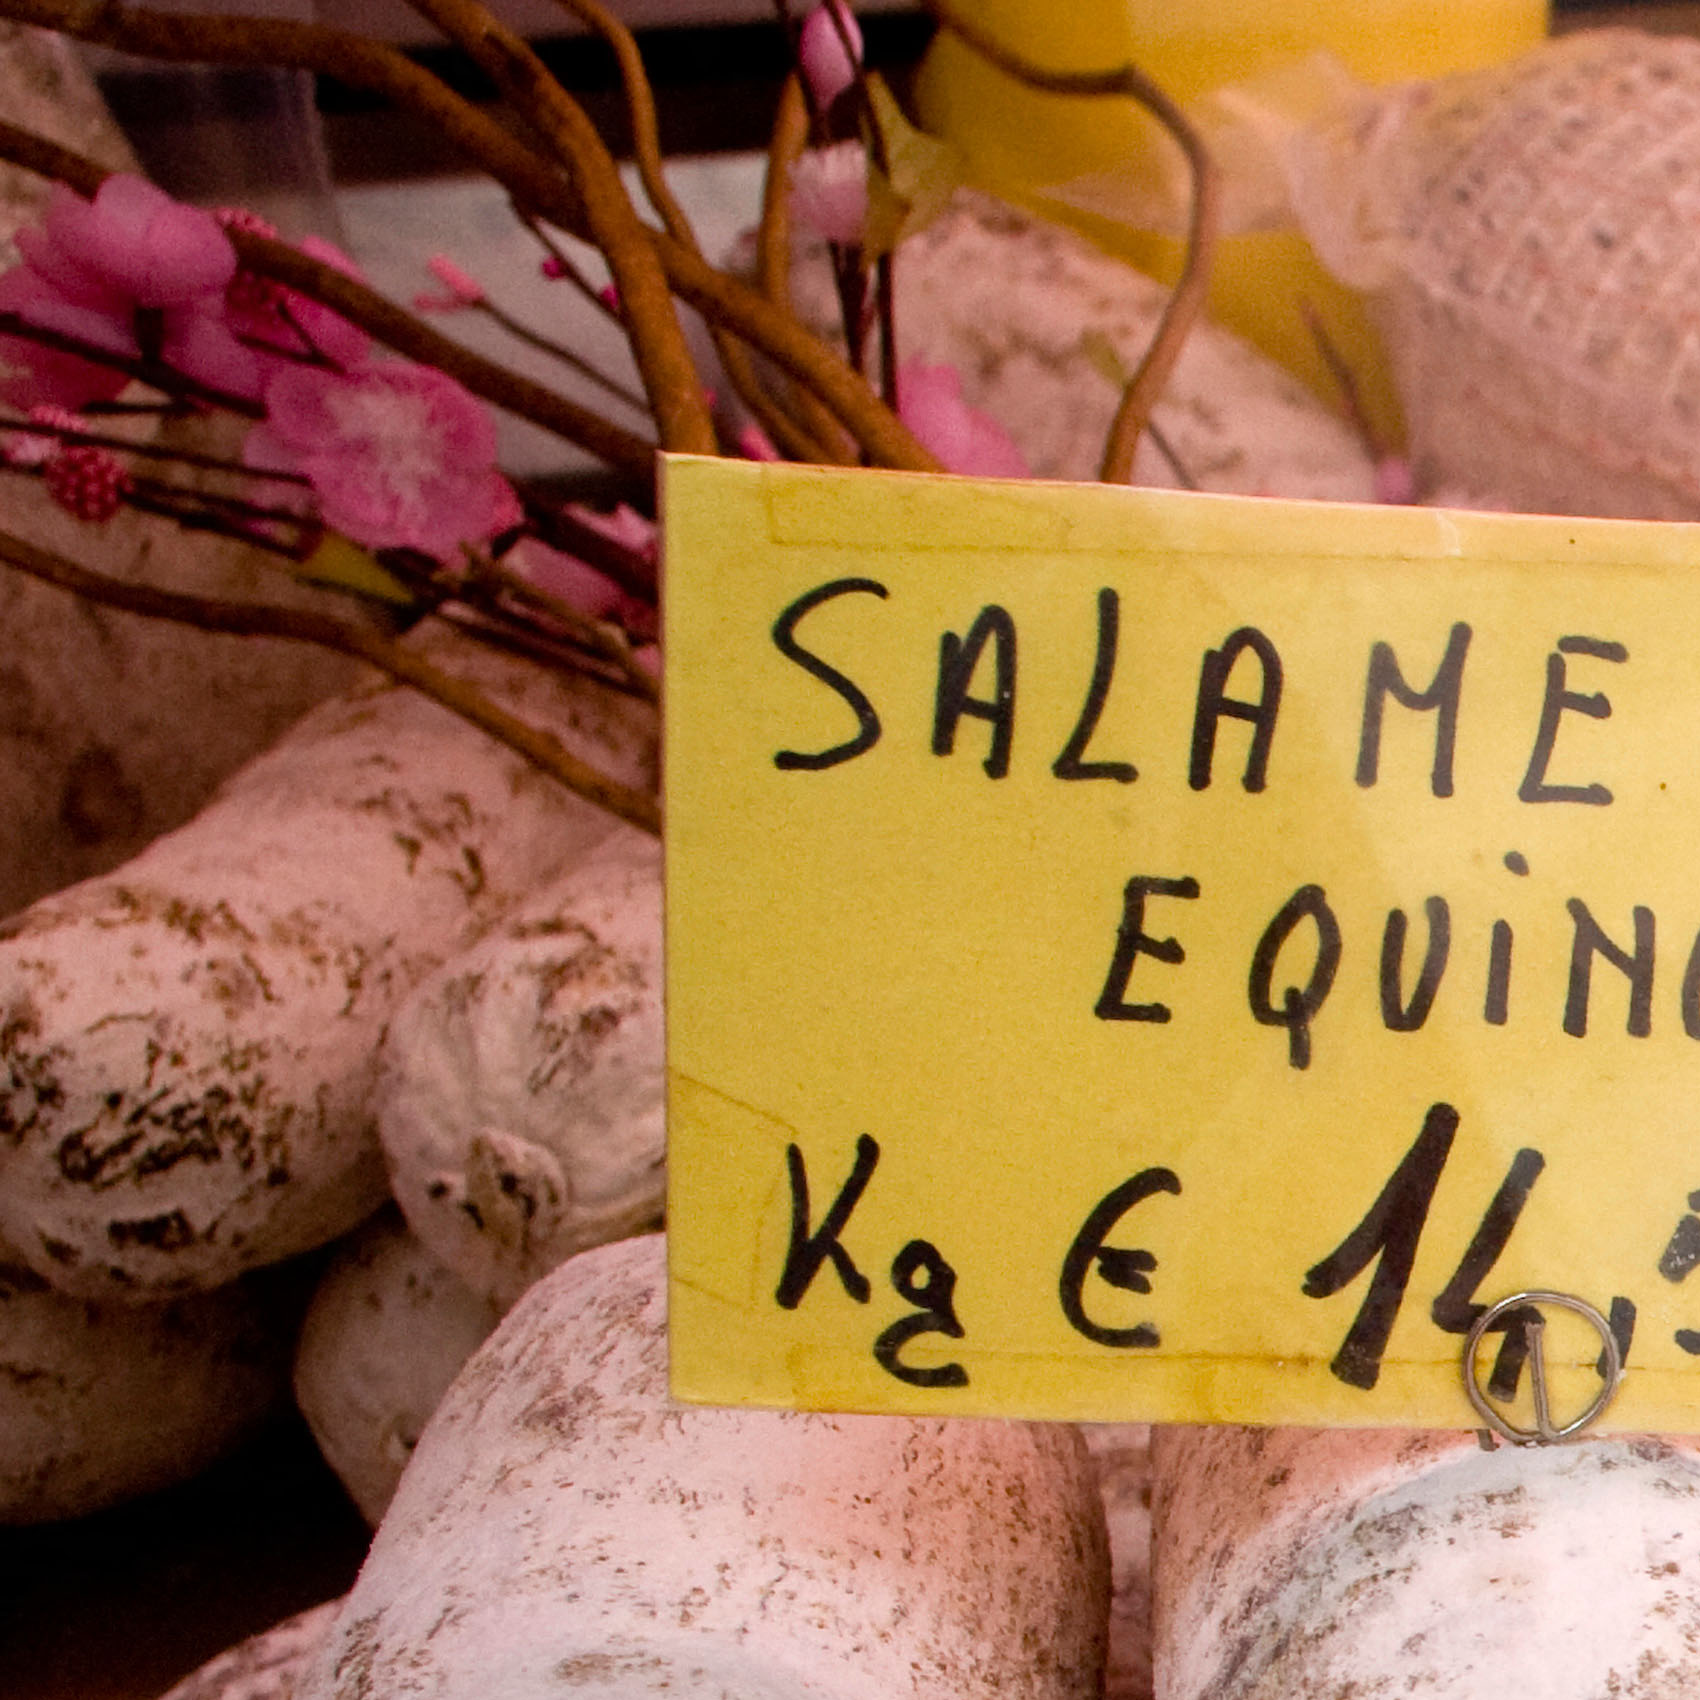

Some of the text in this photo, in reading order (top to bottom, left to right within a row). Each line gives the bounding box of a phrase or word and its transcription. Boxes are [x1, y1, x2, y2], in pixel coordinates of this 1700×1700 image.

[770, 576, 1630, 805] SALAME
[774, 1131, 971, 1389] Kg
[1058, 1165, 1183, 1350] €
